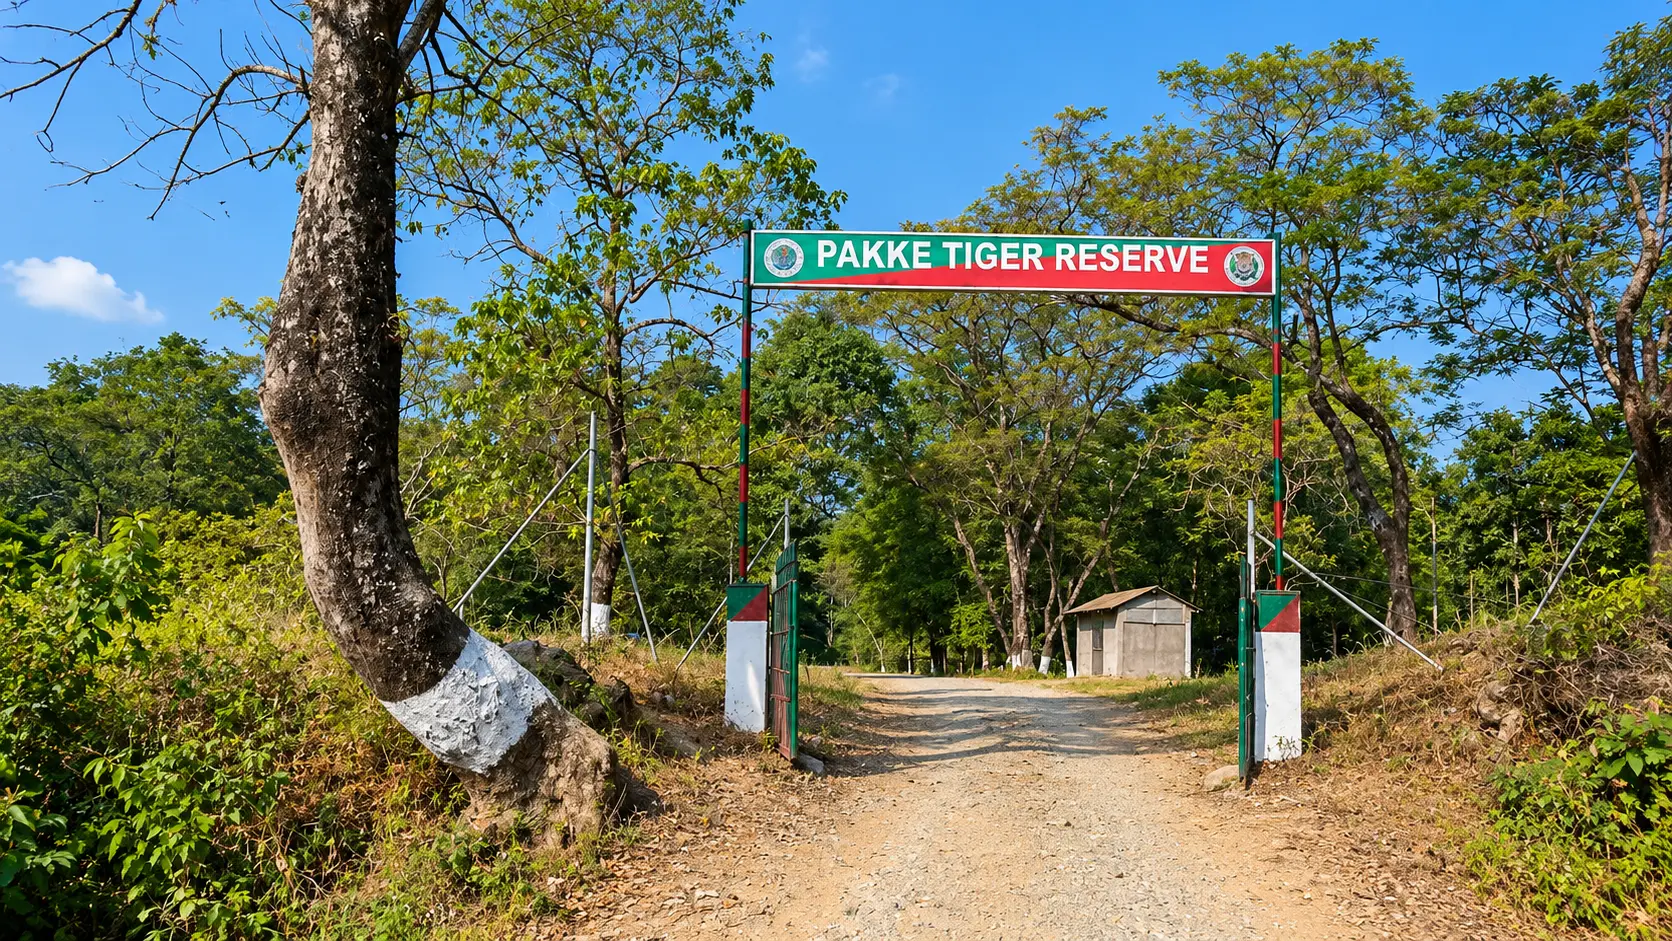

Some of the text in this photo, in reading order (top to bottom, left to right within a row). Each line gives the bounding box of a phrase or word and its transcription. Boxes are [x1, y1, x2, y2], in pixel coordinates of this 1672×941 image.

[817, 239, 932, 270] PAKKE
[942, 241, 1044, 271] TIGER
[1055, 243, 1209, 274] RESERVE
